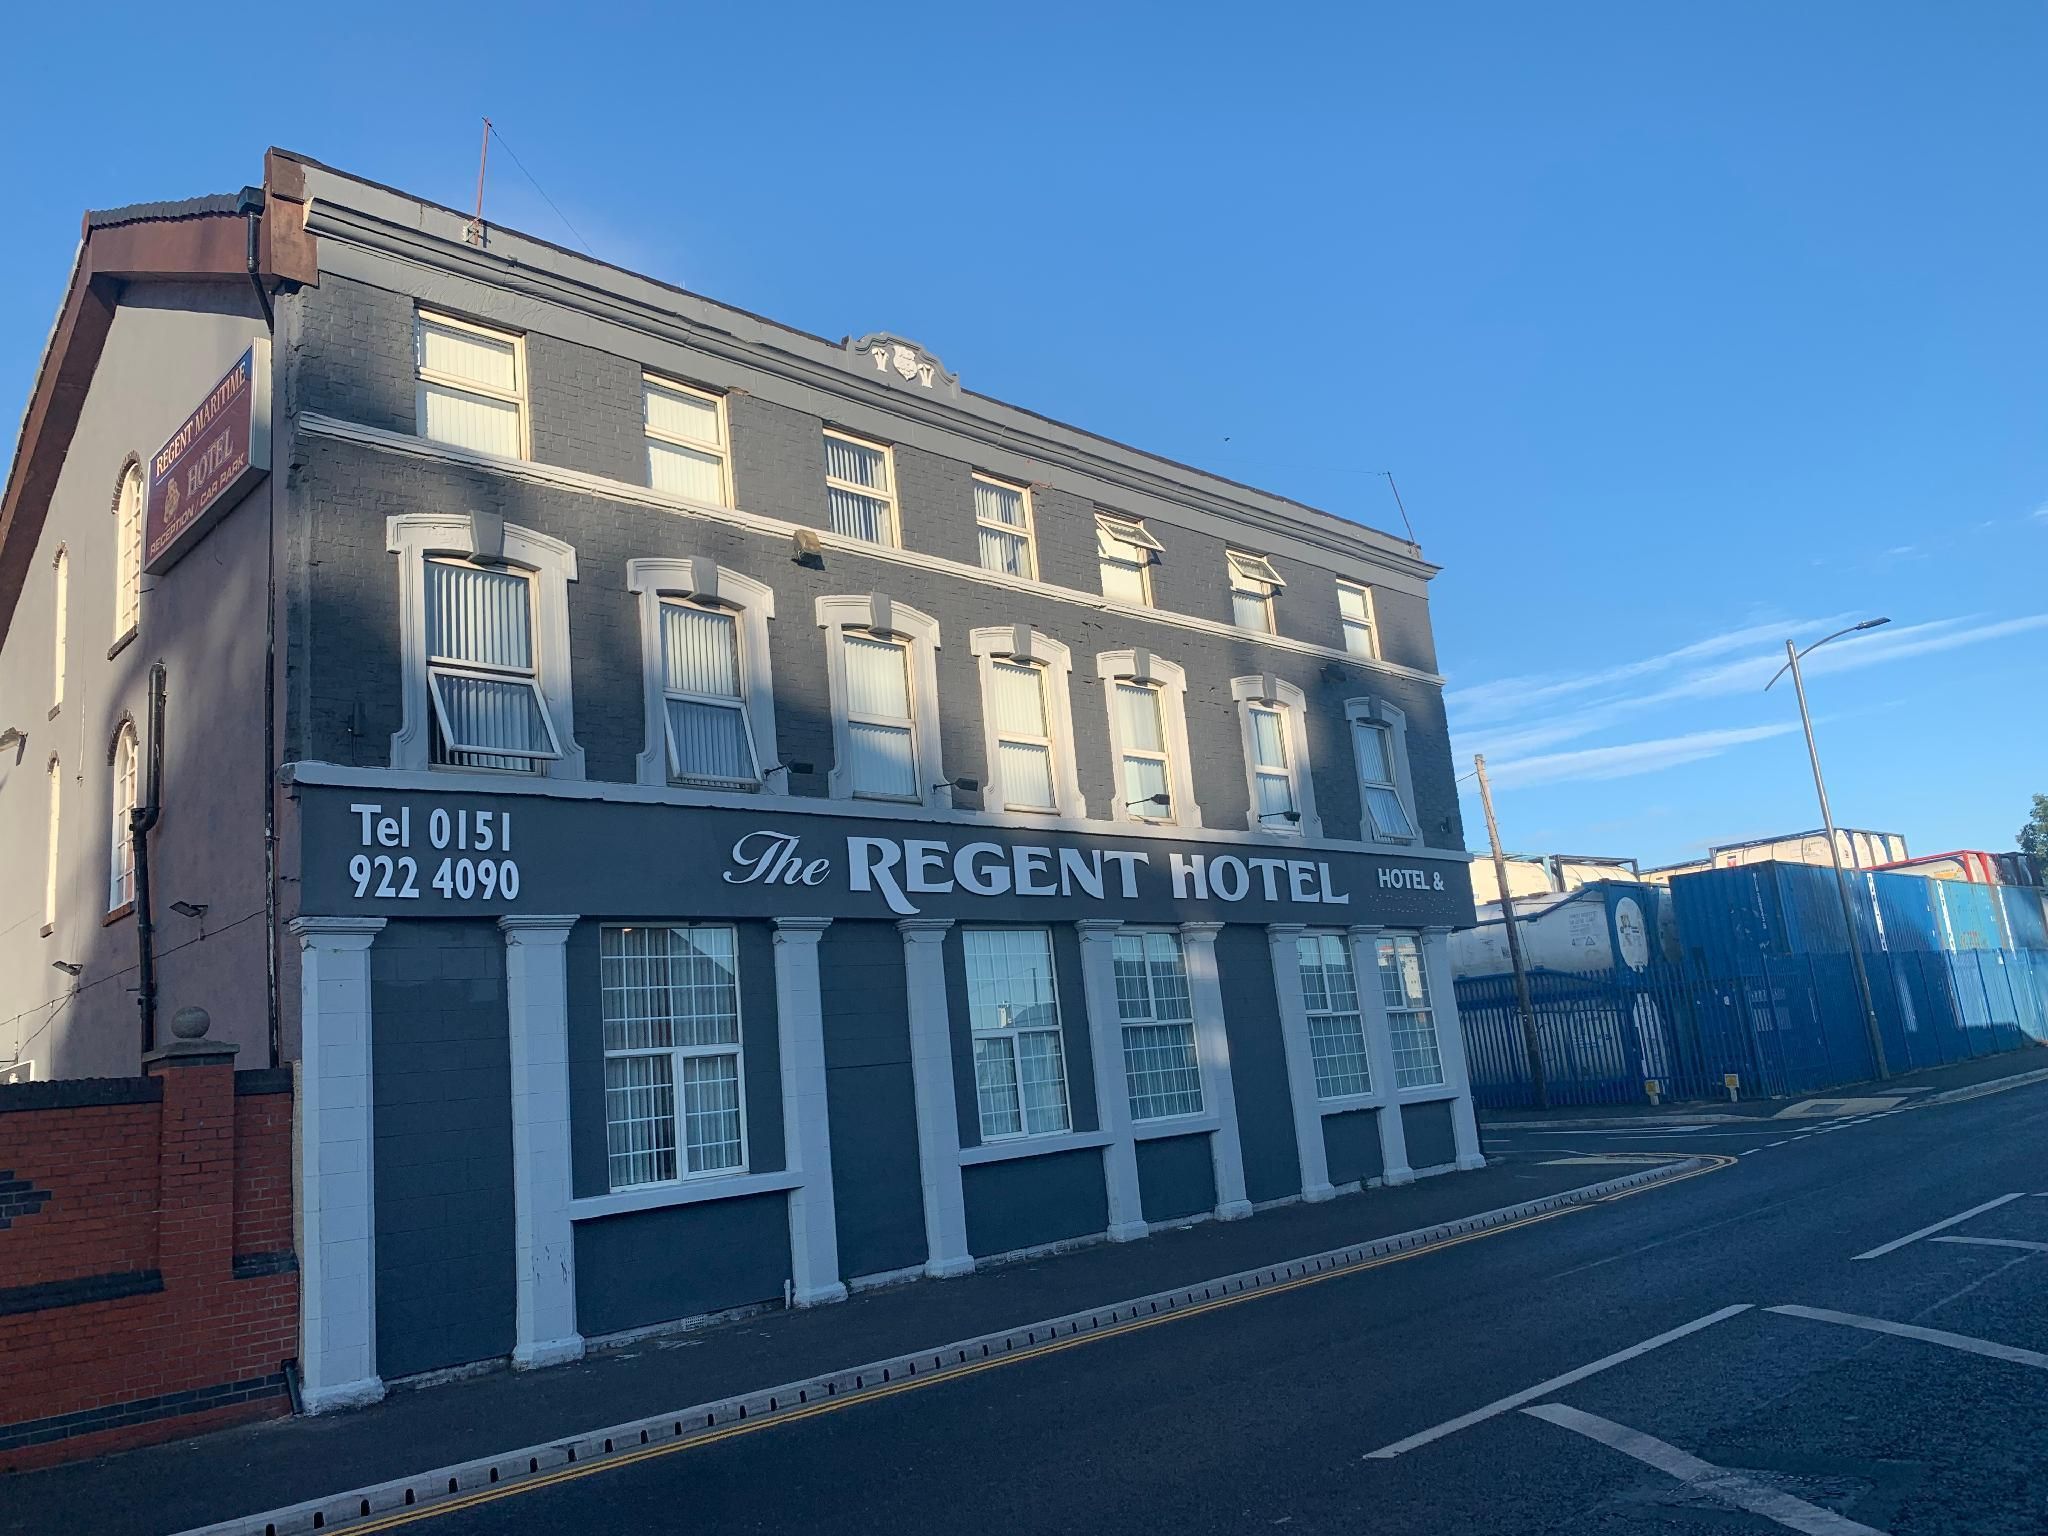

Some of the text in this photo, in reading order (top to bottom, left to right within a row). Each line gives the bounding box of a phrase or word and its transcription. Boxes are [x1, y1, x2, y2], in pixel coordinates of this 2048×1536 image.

[156, 361, 246, 477] REGENT MARITIME
[186, 425, 234, 498] HOTEL
[149, 508, 194, 556] RECEPTION
[200, 480, 218, 505] CAR
[219, 453, 245, 487] PARK
[350, 803, 511, 852] Tel 0151
[348, 854, 519, 899] 922 4090
[723, 830, 1349, 915] The REGENT HOTEL
[1378, 867, 1445, 891] HOTEL &
